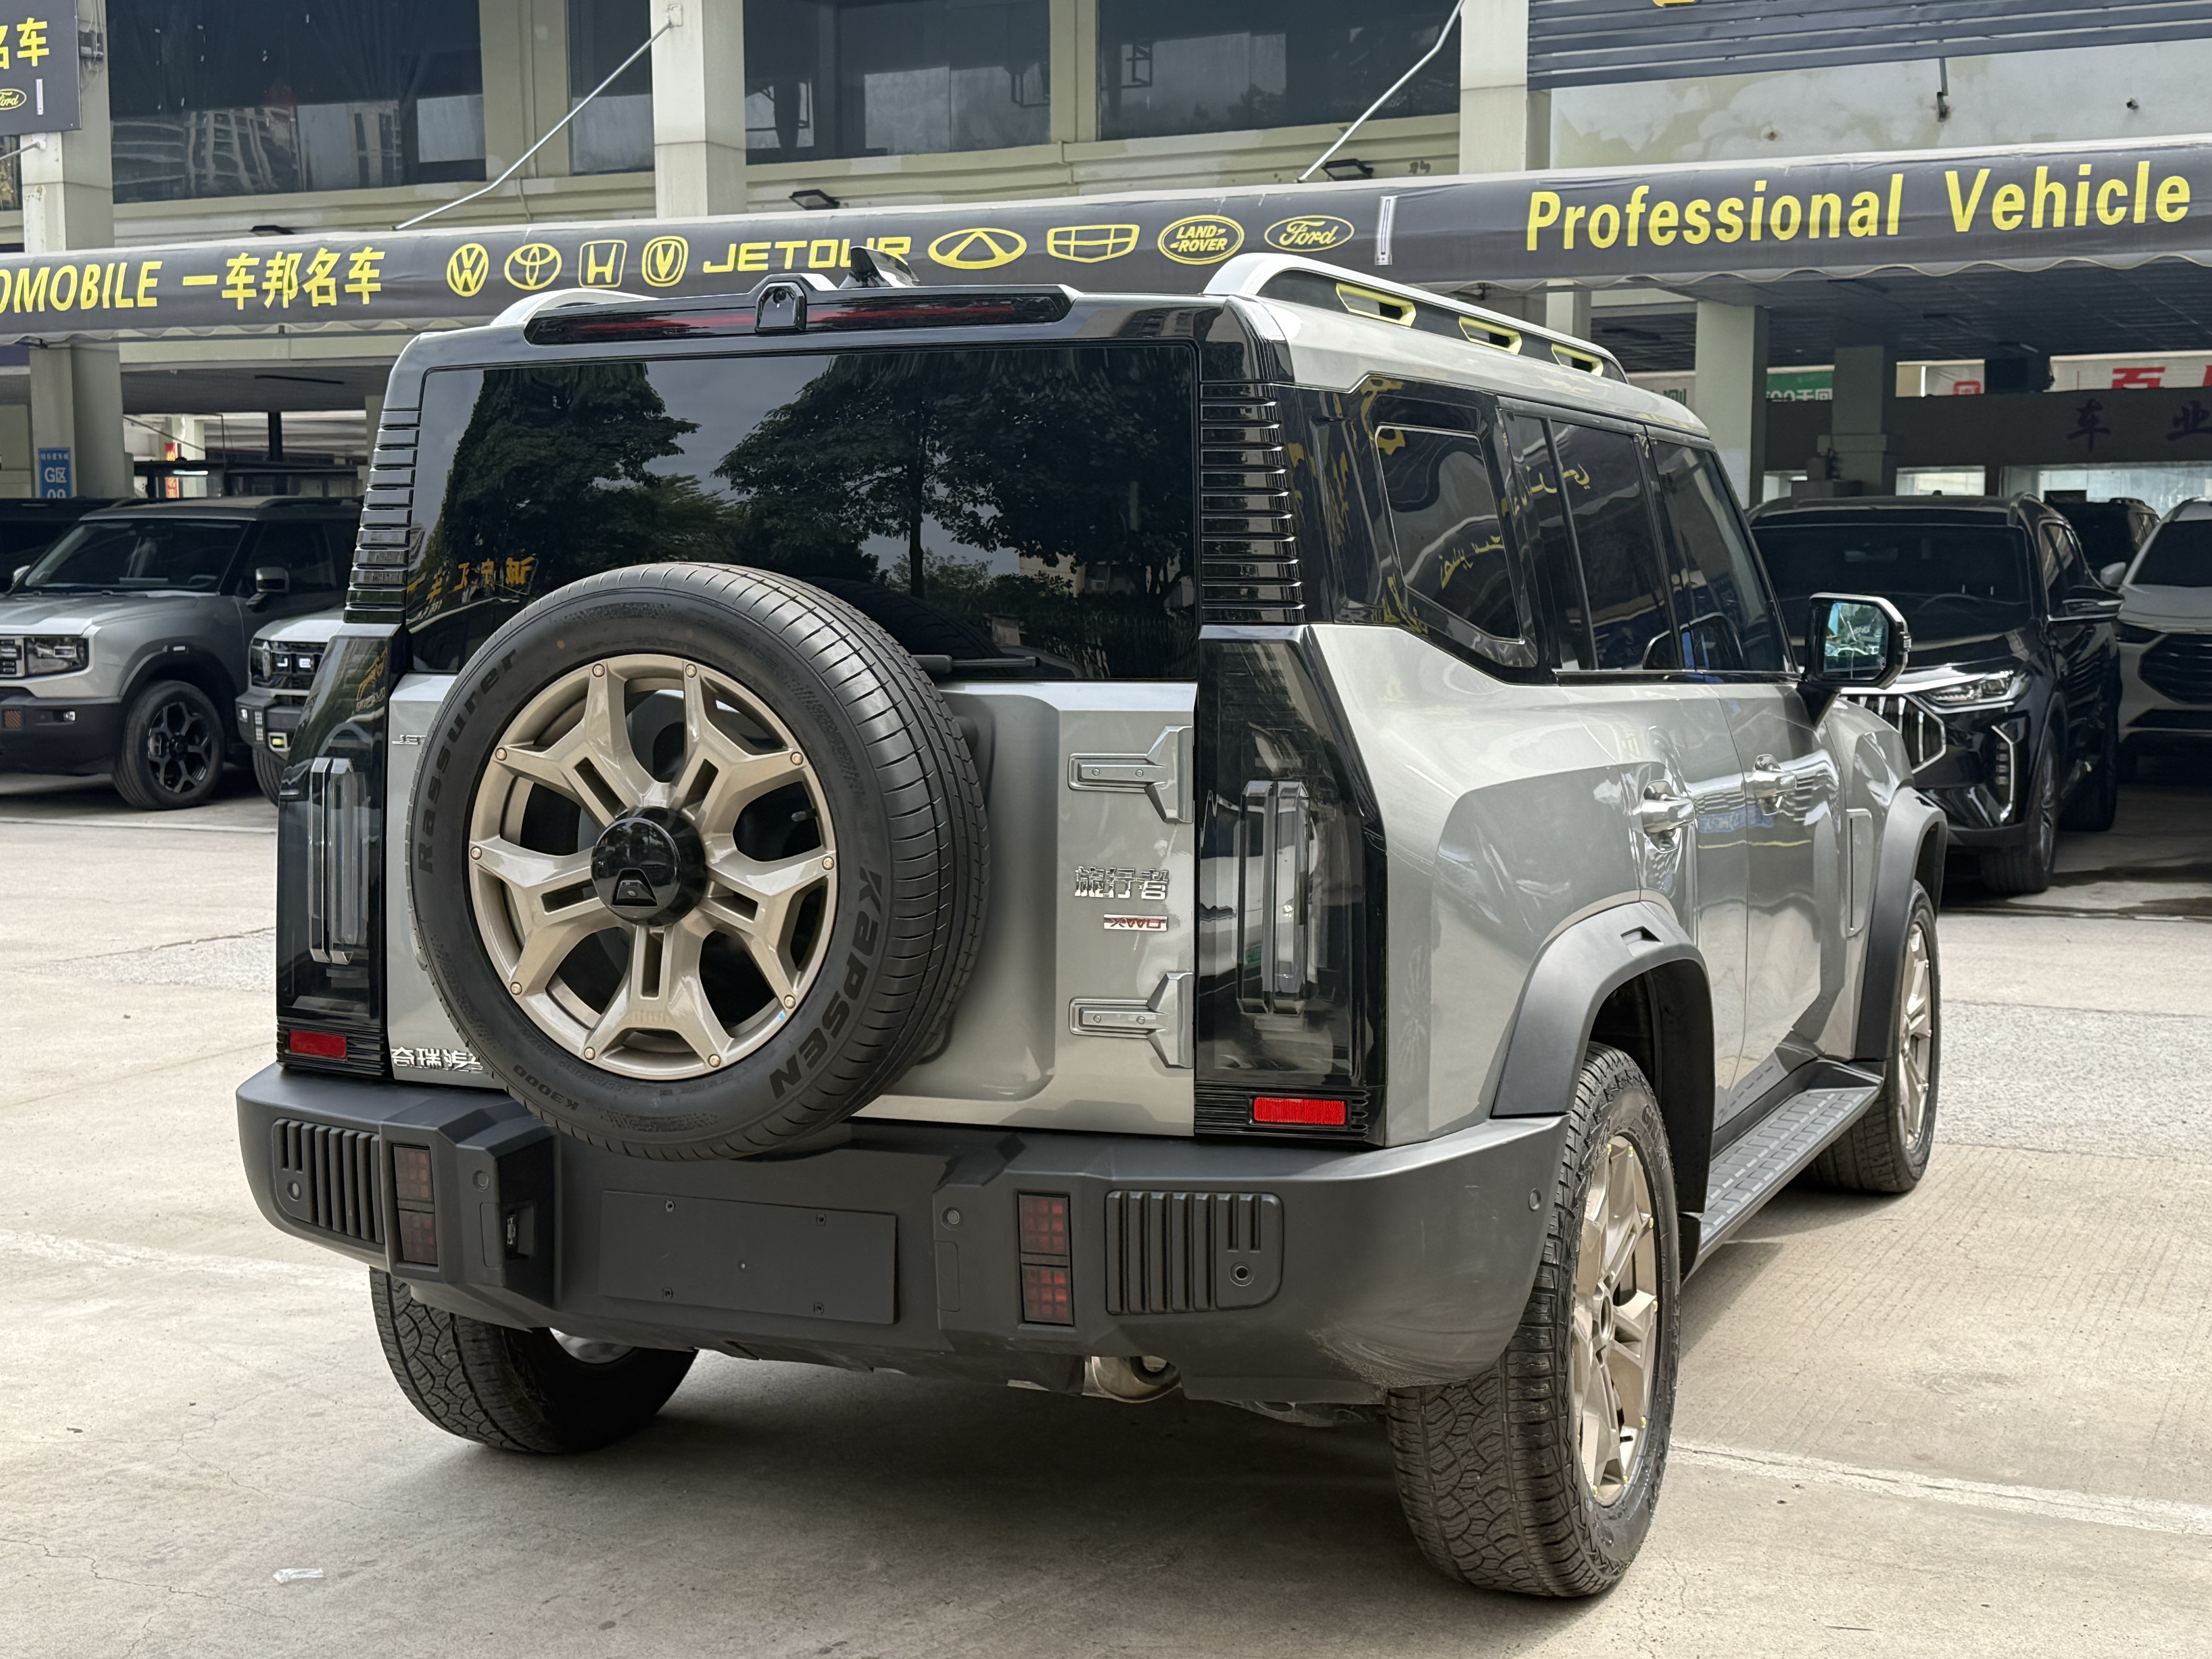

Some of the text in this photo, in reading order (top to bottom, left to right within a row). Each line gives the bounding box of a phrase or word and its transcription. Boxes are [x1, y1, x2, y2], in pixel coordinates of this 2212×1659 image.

[0, 17, 50, 69] 车
[1525, 160, 2191, 251] Professional Vehicle
[1176, 225, 1219, 239] LAND
[1178, 238, 1228, 252] ROVER
[1279, 220, 1339, 246] Ford
[182, 247, 386, 310] 一车邦名车
[418, 649, 516, 874] Rassurer
[1075, 866, 1169, 899] 旅行者
[1110, 917, 1161, 929] XWD
[514, 1065, 579, 1111] K3000
